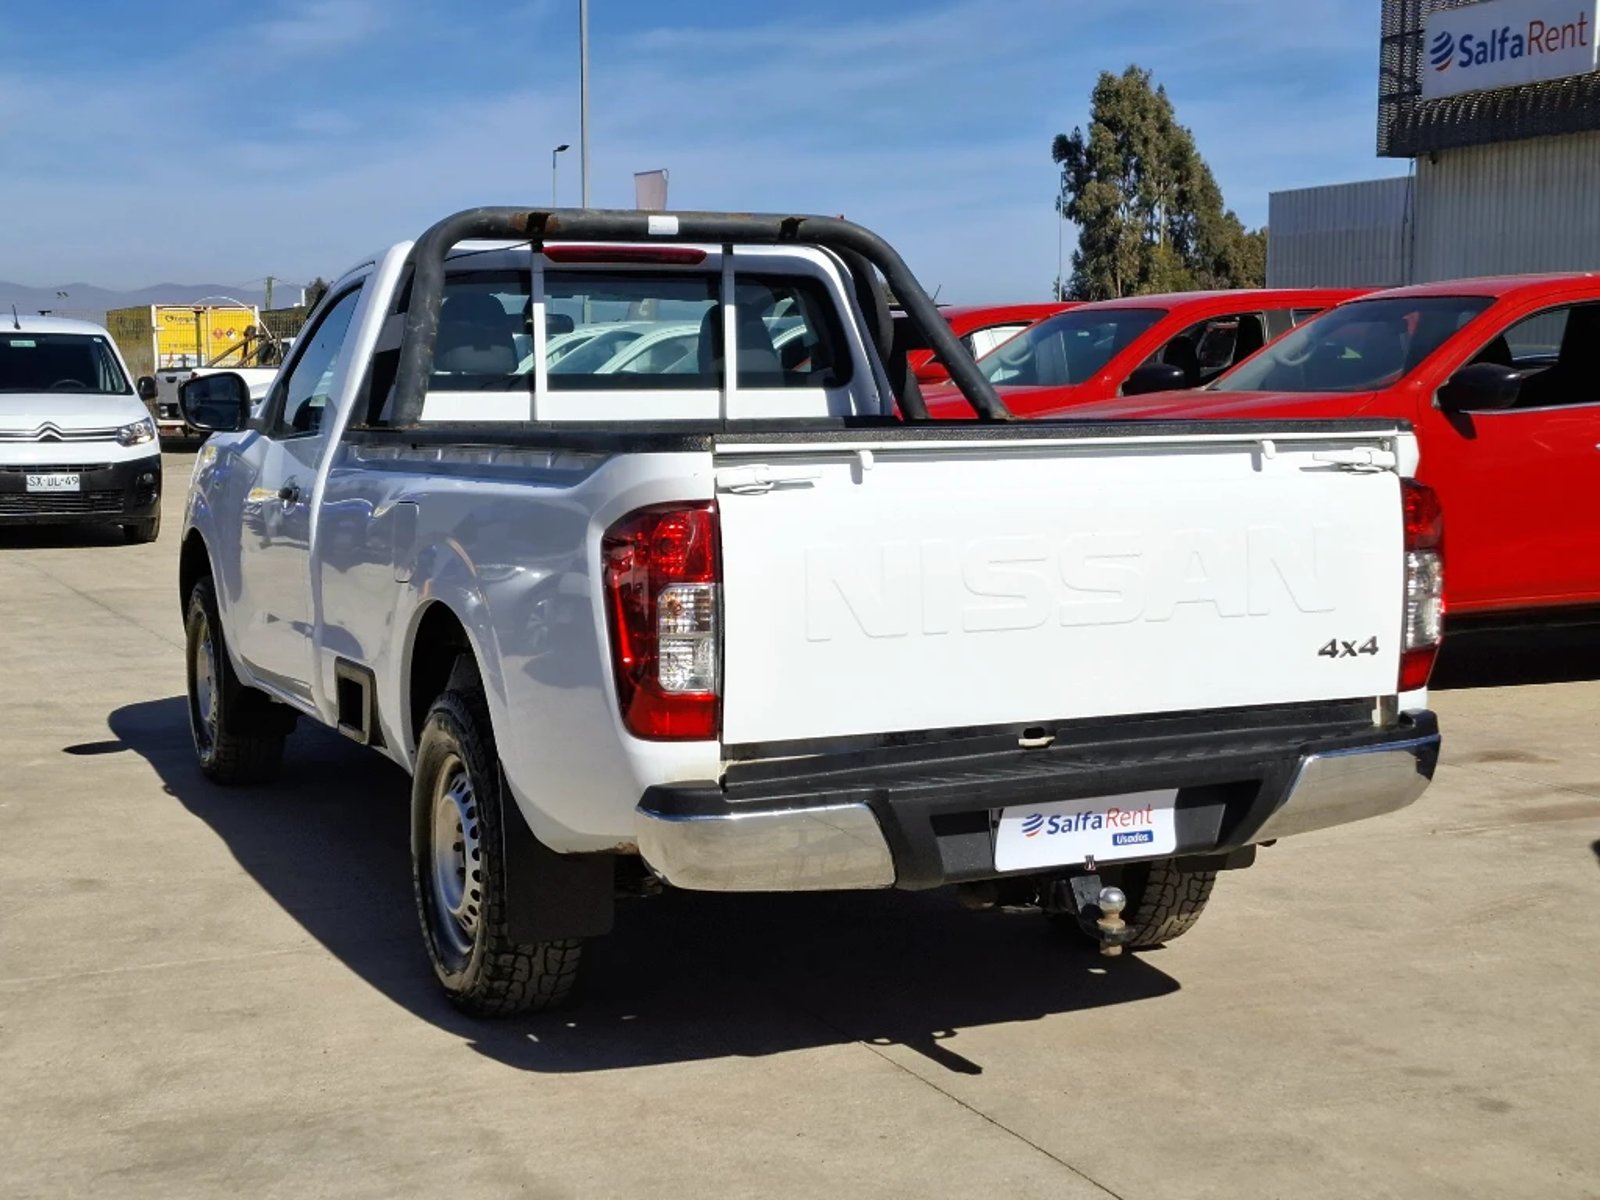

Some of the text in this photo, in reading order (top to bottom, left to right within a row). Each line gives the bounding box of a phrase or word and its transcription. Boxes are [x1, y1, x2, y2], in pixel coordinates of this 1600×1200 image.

[805, 521, 1336, 643] NISSAN
[1317, 635, 1379, 658] 4x4
[1116, 832, 1149, 844] Usados
